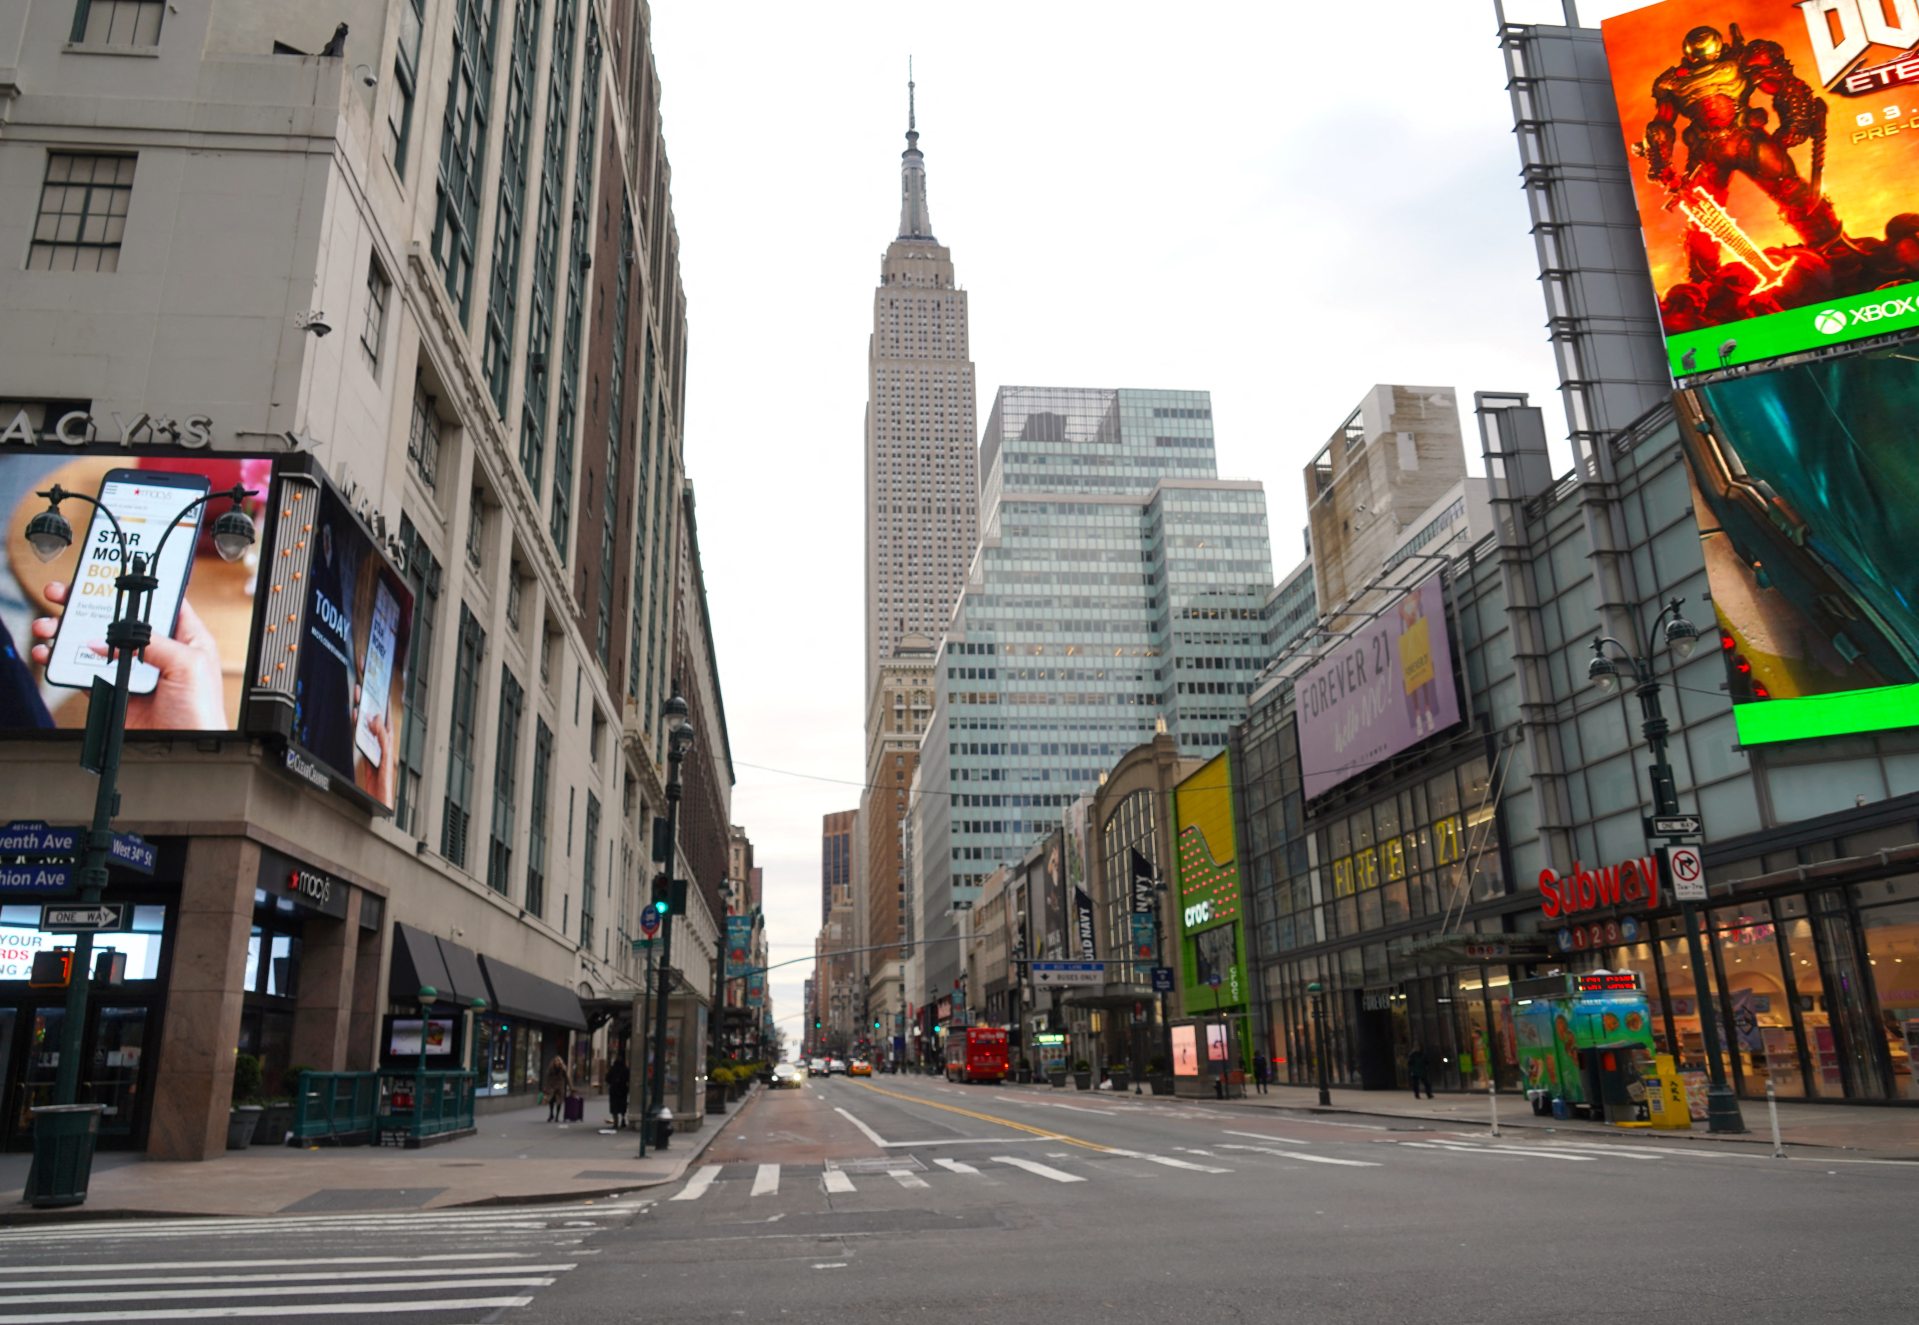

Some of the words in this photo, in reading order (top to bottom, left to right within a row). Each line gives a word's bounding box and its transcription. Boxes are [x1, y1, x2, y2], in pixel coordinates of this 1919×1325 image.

[1849, 297, 1917, 325] XBOX
[98, 530, 141, 546] STAR
[87, 564, 129, 579] BON
[81, 582, 122, 598] DAY
[316, 589, 351, 642] TODAY
[1302, 647, 1367, 724] FOREVER
[1373, 629, 1391, 676] 21
[43, 834, 73, 849] Ave
[1334, 836, 1405, 897] FOREE
[1435, 816, 1458, 865] 21
[35, 870, 65, 886] Ave
[1540, 854, 1657, 918] Subway
[1136, 874, 1152, 912] NAVY
[55, 912, 76, 921] ONE
[87, 912, 109, 921] WAY
[1080, 907, 1091, 938] NAVY
[0, 935, 42, 947] YOUR
[1576, 930, 1583, 946] 1
[1592, 927, 1601, 944] 2
[1607, 923, 1616, 940] 3
